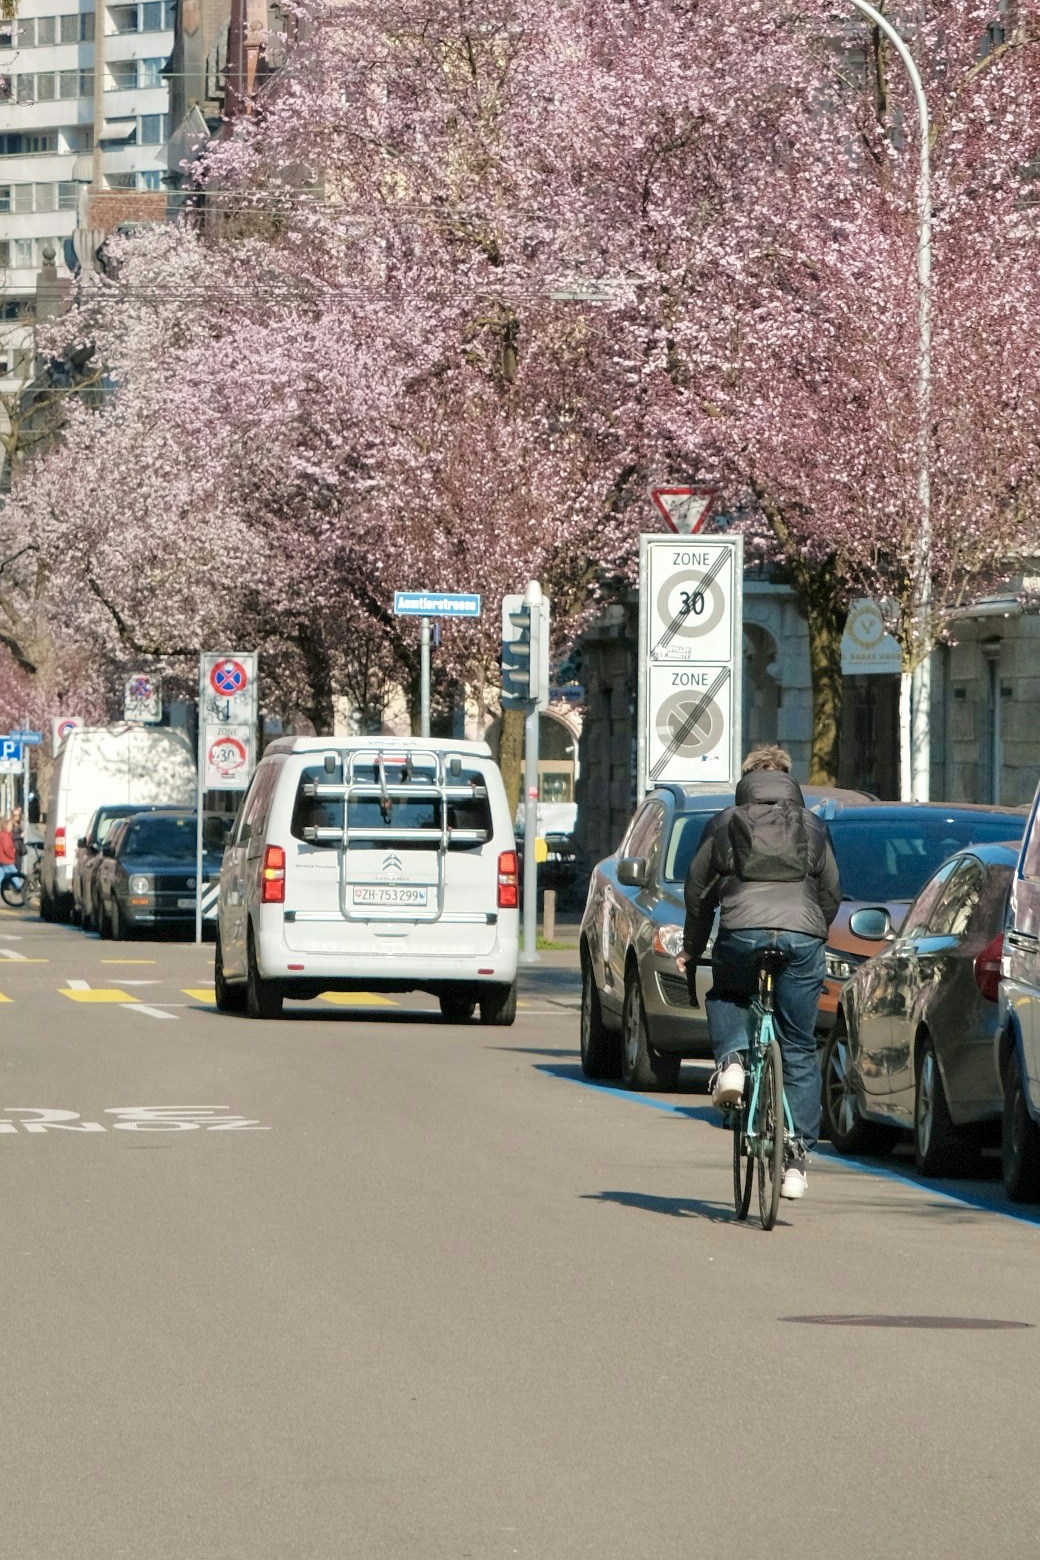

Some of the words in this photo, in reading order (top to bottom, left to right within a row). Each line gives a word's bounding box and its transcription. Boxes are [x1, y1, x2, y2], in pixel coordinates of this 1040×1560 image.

[673, 553, 710, 566] ZONE
[679, 591, 705, 615] 30
[672, 673, 708, 686] ZONE
[217, 728, 238, 736] ZONE
